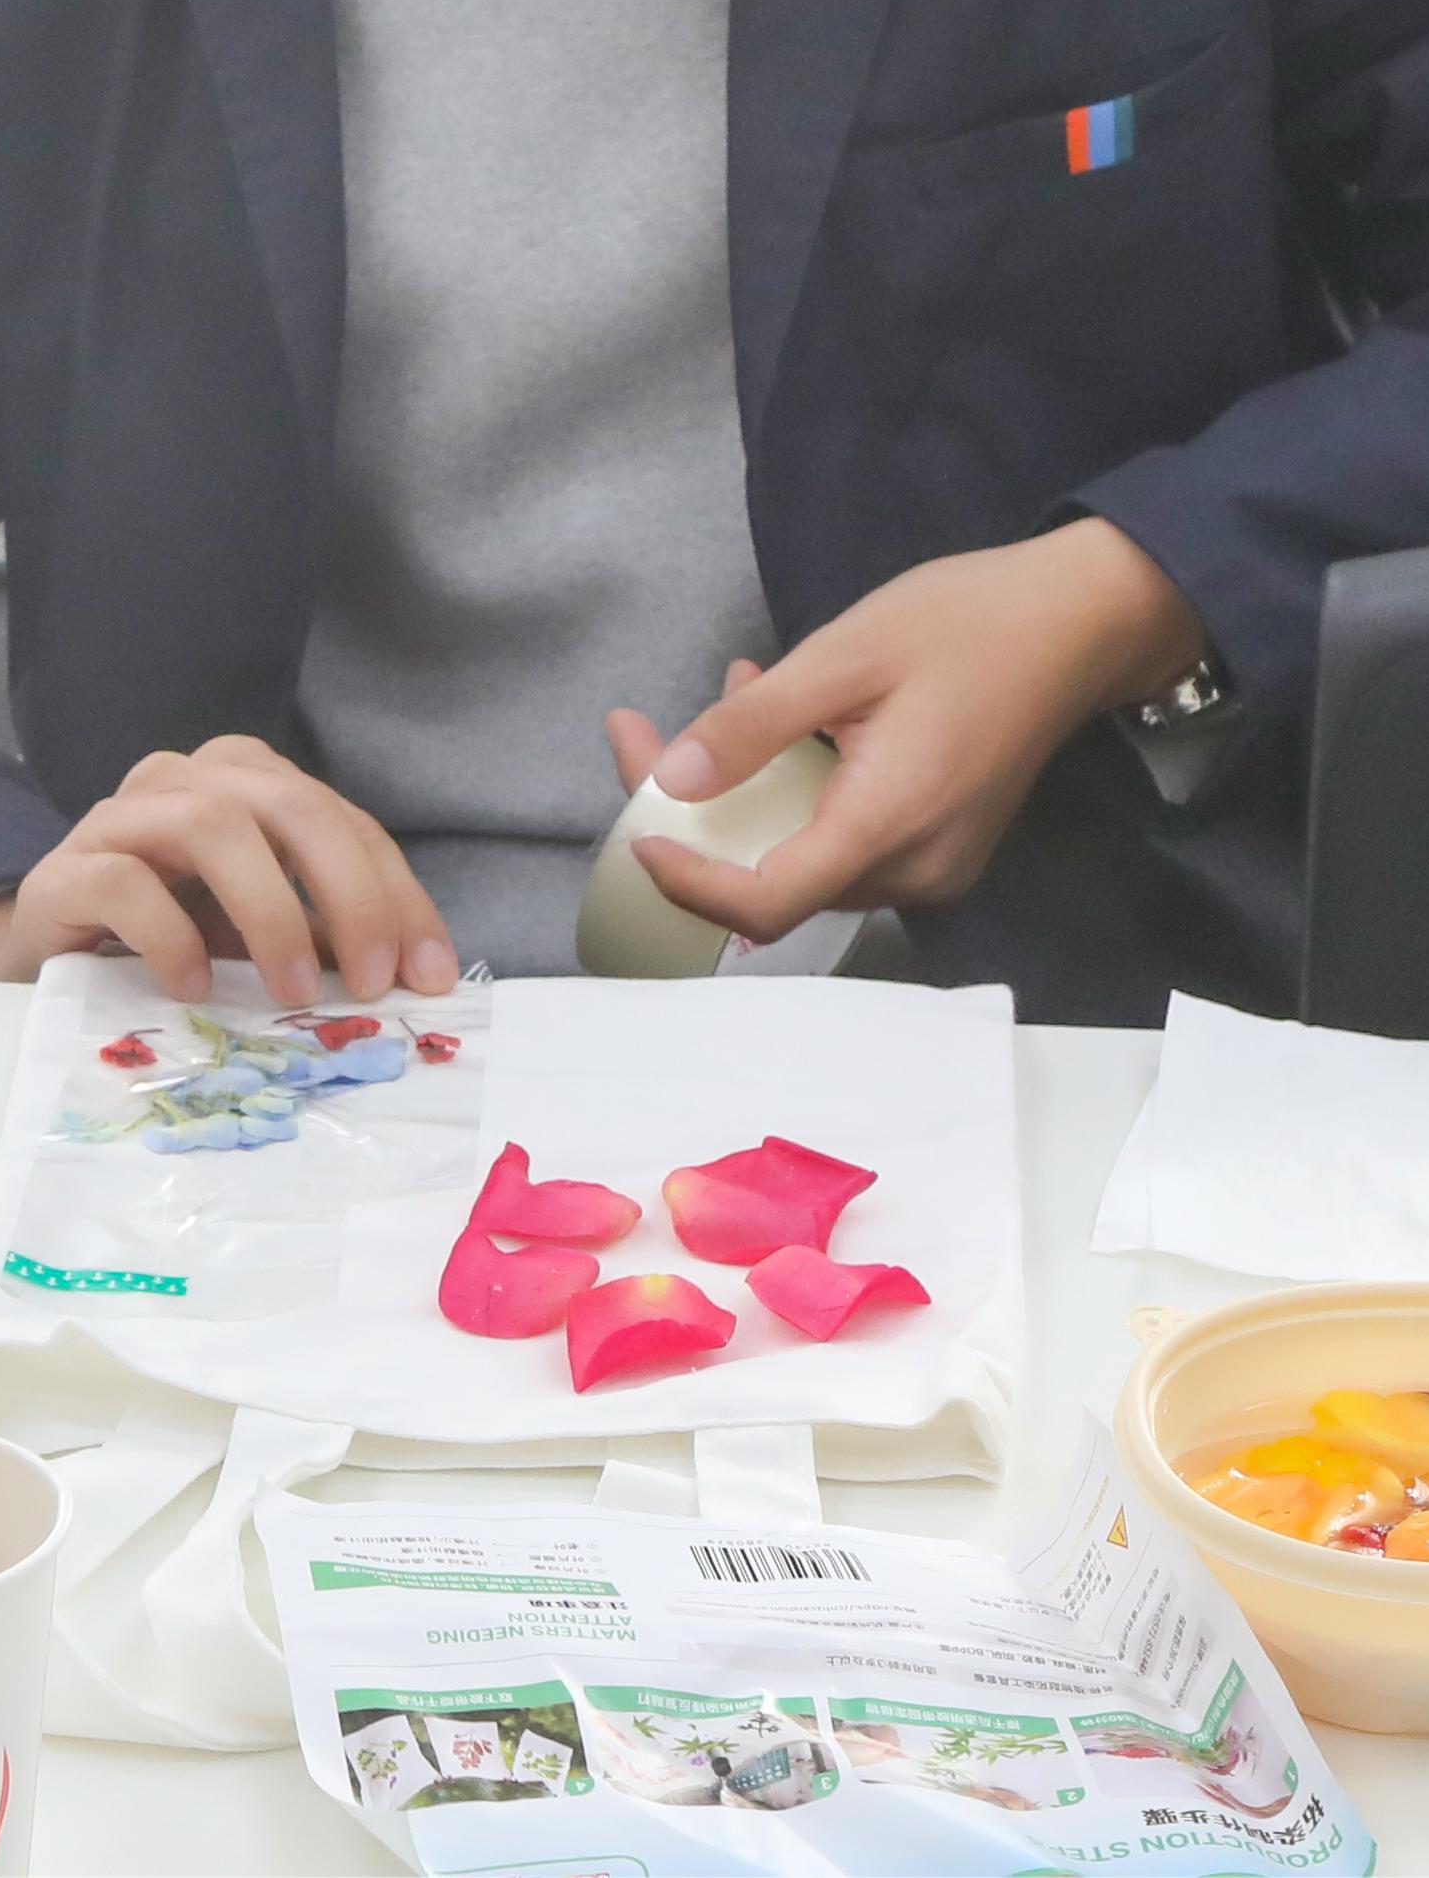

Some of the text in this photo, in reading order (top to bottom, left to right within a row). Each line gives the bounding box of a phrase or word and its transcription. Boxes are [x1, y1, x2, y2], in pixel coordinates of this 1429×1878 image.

[528, 1599, 628, 1610] 注意事项
[506, 1612, 633, 1627] ATTENTION
[426, 1625, 637, 1644] MATTERS NEEDING
[576, 1780, 587, 1792] 4
[821, 1776, 832, 1790] 3
[1066, 1790, 1077, 1801] 2
[1141, 1793, 1325, 1846] 拓染制作步骤
[1140, 1824, 1343, 1868] PRODUCTION
